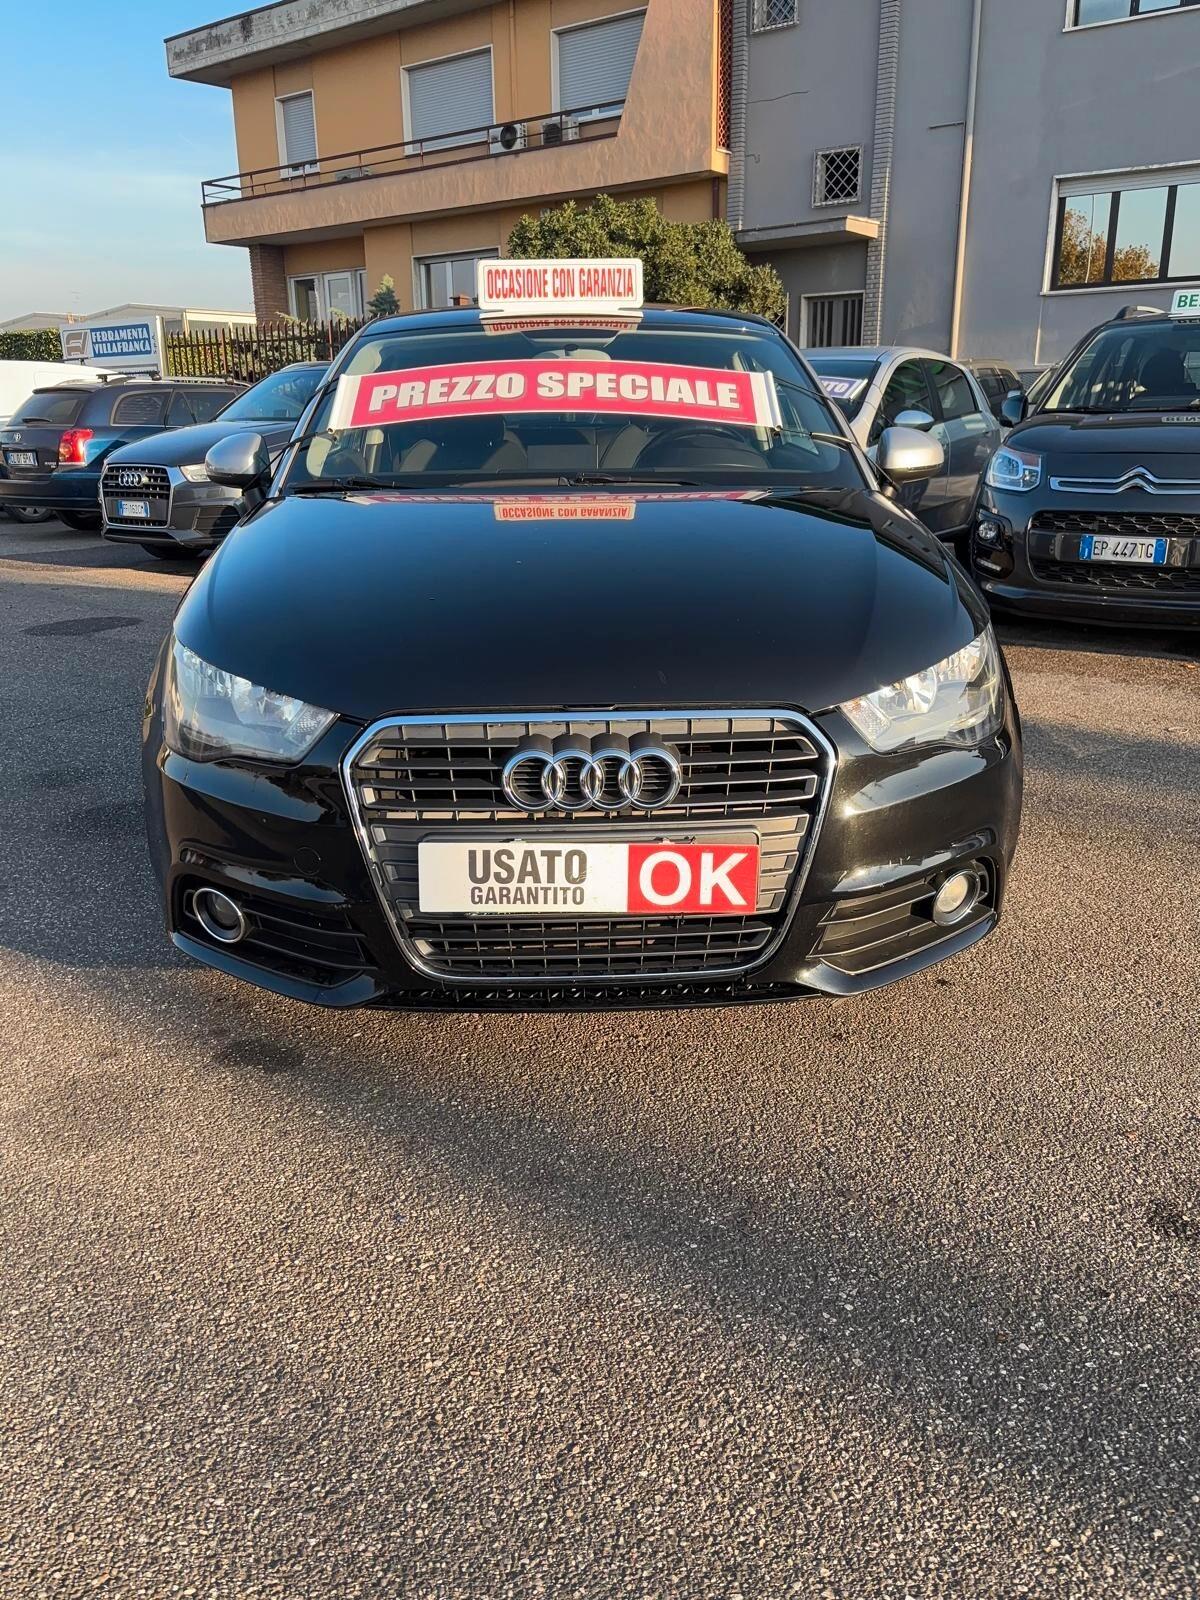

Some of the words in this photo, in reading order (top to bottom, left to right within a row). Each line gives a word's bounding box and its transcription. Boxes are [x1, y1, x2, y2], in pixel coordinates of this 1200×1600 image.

[487, 268, 548, 299] OCCASIONE
[552, 268, 575, 298] CON
[579, 267, 634, 298] GARANZIA
[1177, 294, 1200, 308] BE
[91, 327, 149, 342] FERRAMENTA
[93, 340, 151, 354] VILLAFRANCA
[368, 373, 525, 412] PREZZO
[536, 371, 741, 409] SPECIALE
[1092, 540, 1108, 556] EP
[1113, 541, 1154, 559] 447TG
[467, 849, 588, 885] USATO
[638, 850, 749, 907] OK
[470, 886, 585, 906] GARANTITO
